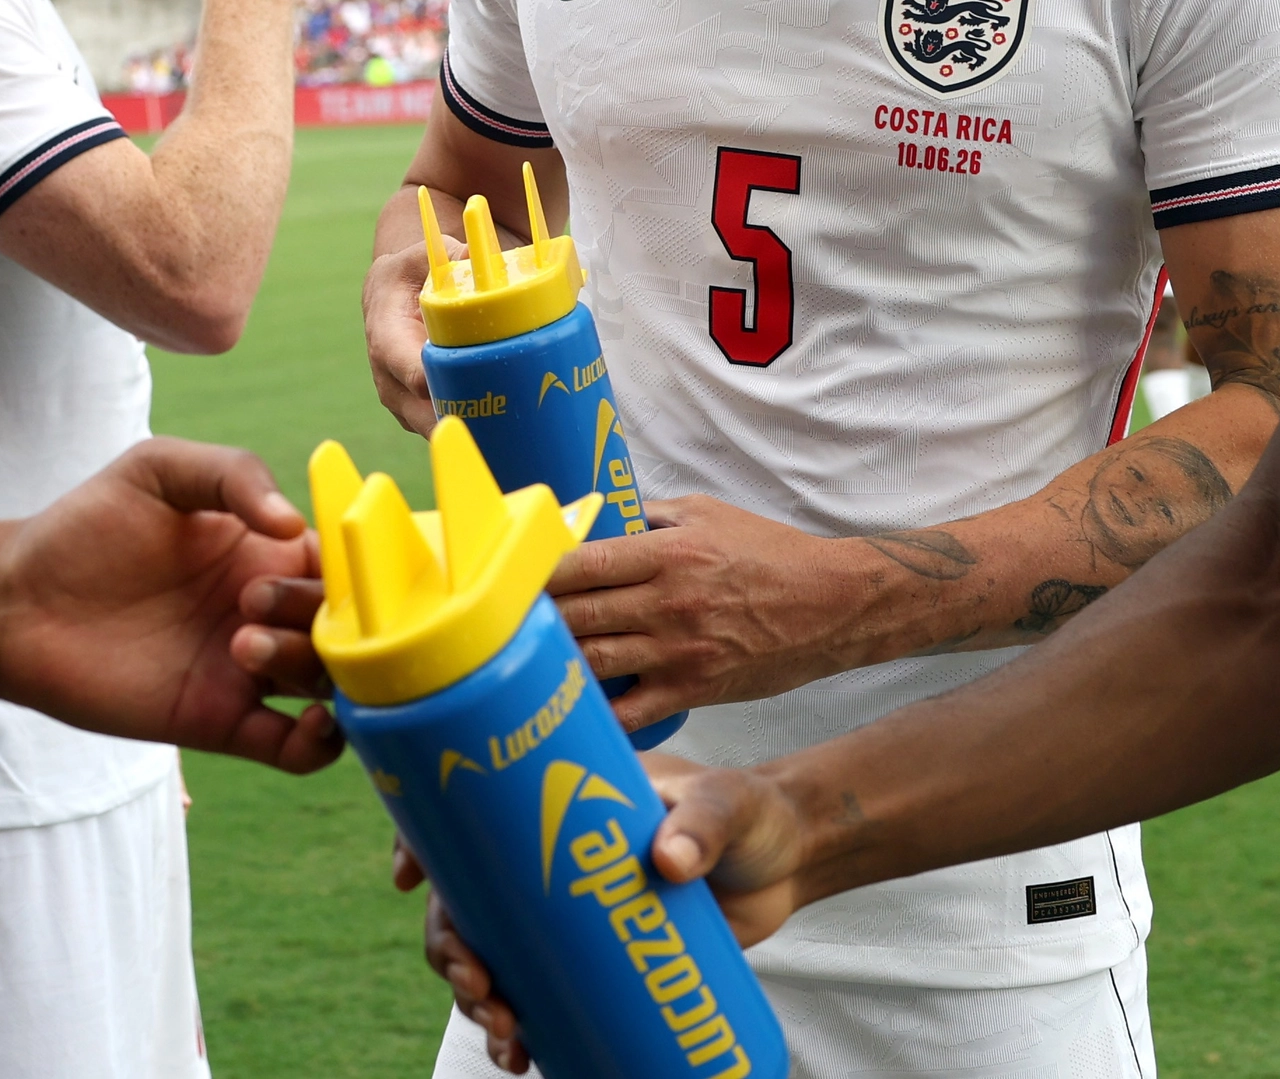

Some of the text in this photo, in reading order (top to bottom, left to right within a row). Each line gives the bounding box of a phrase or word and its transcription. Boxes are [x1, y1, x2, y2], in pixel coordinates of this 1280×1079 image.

[874, 104, 1012, 145] COSTA RICA
[898, 141, 983, 176] 10.06.26
[709, 146, 801, 367] 5
[434, 391, 507, 419] ucozade
[488, 659, 587, 771] Lucozade
[570, 819, 752, 1079] Lucozade
